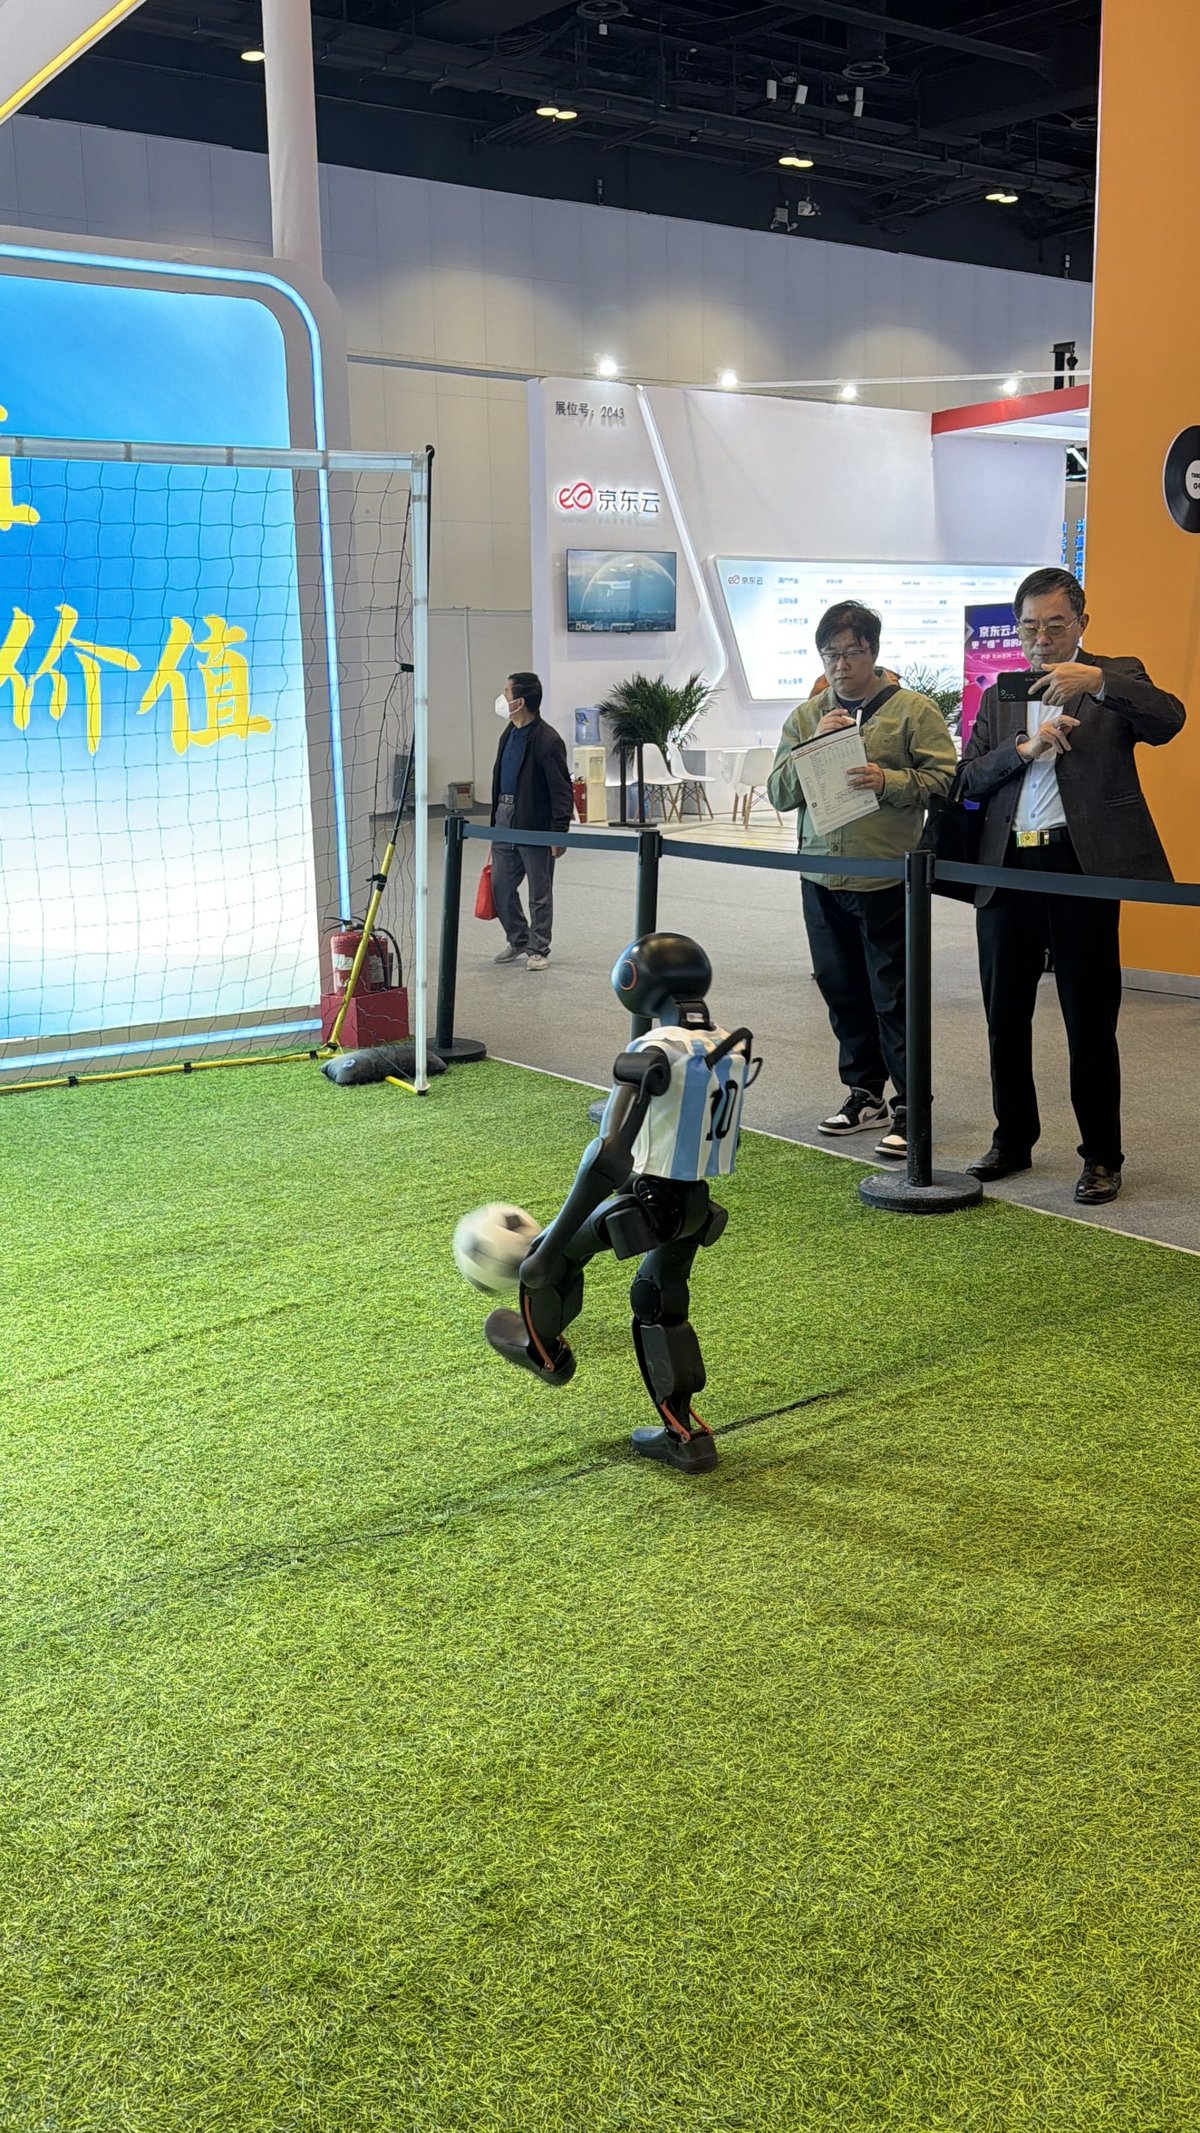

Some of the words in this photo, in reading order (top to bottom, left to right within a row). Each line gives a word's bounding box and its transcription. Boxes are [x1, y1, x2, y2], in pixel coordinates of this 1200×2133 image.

[601, 406, 625, 419] 2043
[598, 490, 660, 513] 京东云
[0, 604, 273, 756] 价值
[706, 1080, 738, 1141] 10
